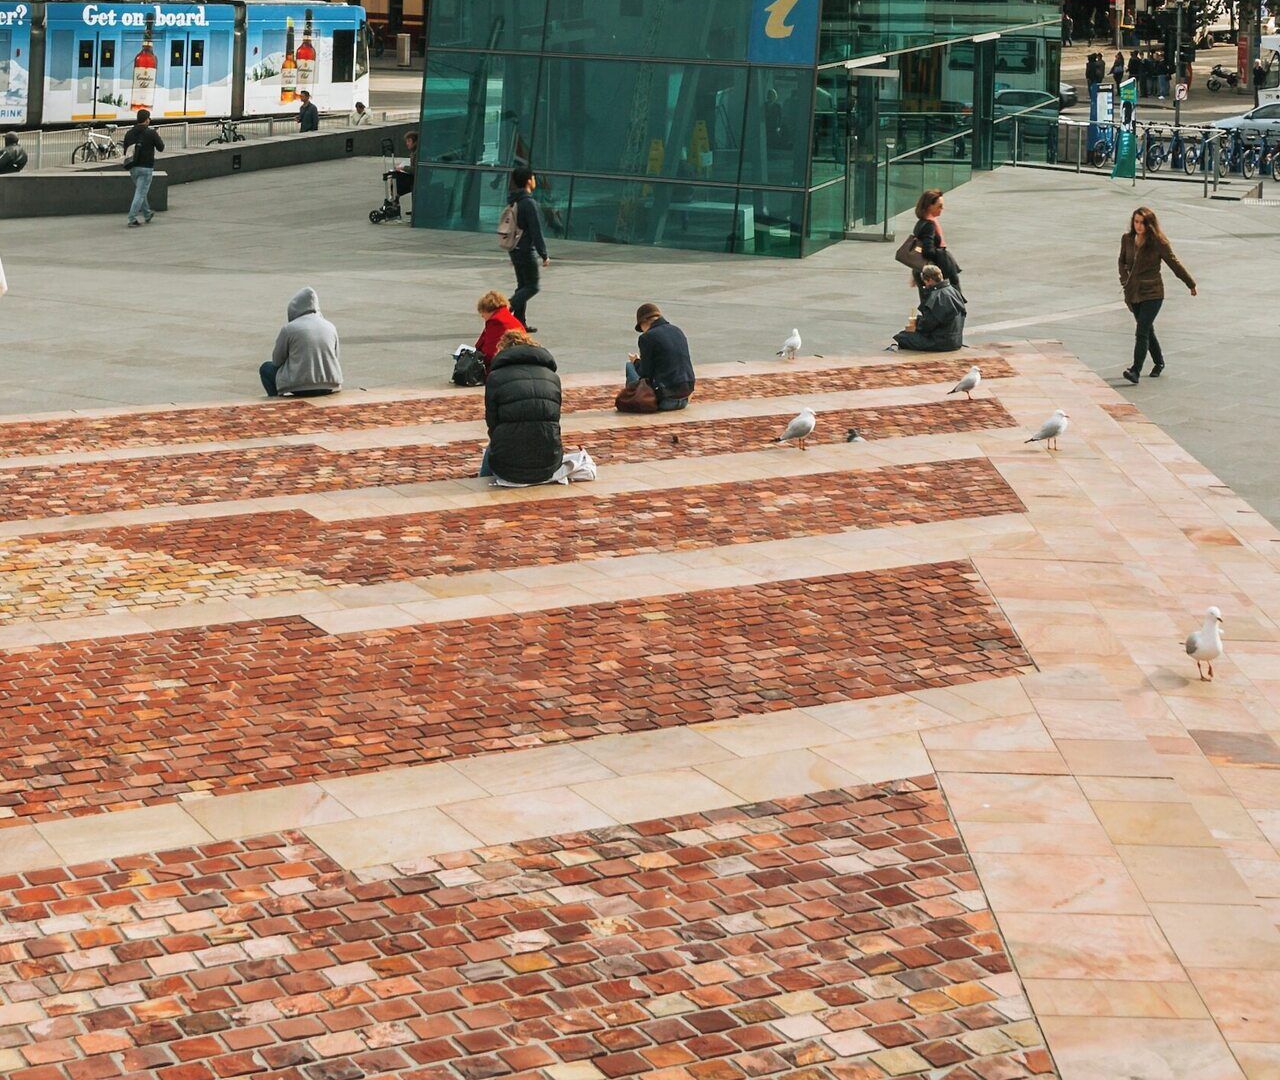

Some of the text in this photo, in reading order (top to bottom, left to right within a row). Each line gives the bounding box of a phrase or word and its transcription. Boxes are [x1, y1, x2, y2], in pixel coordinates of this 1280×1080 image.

[82, 4, 209, 27] Get on board.
